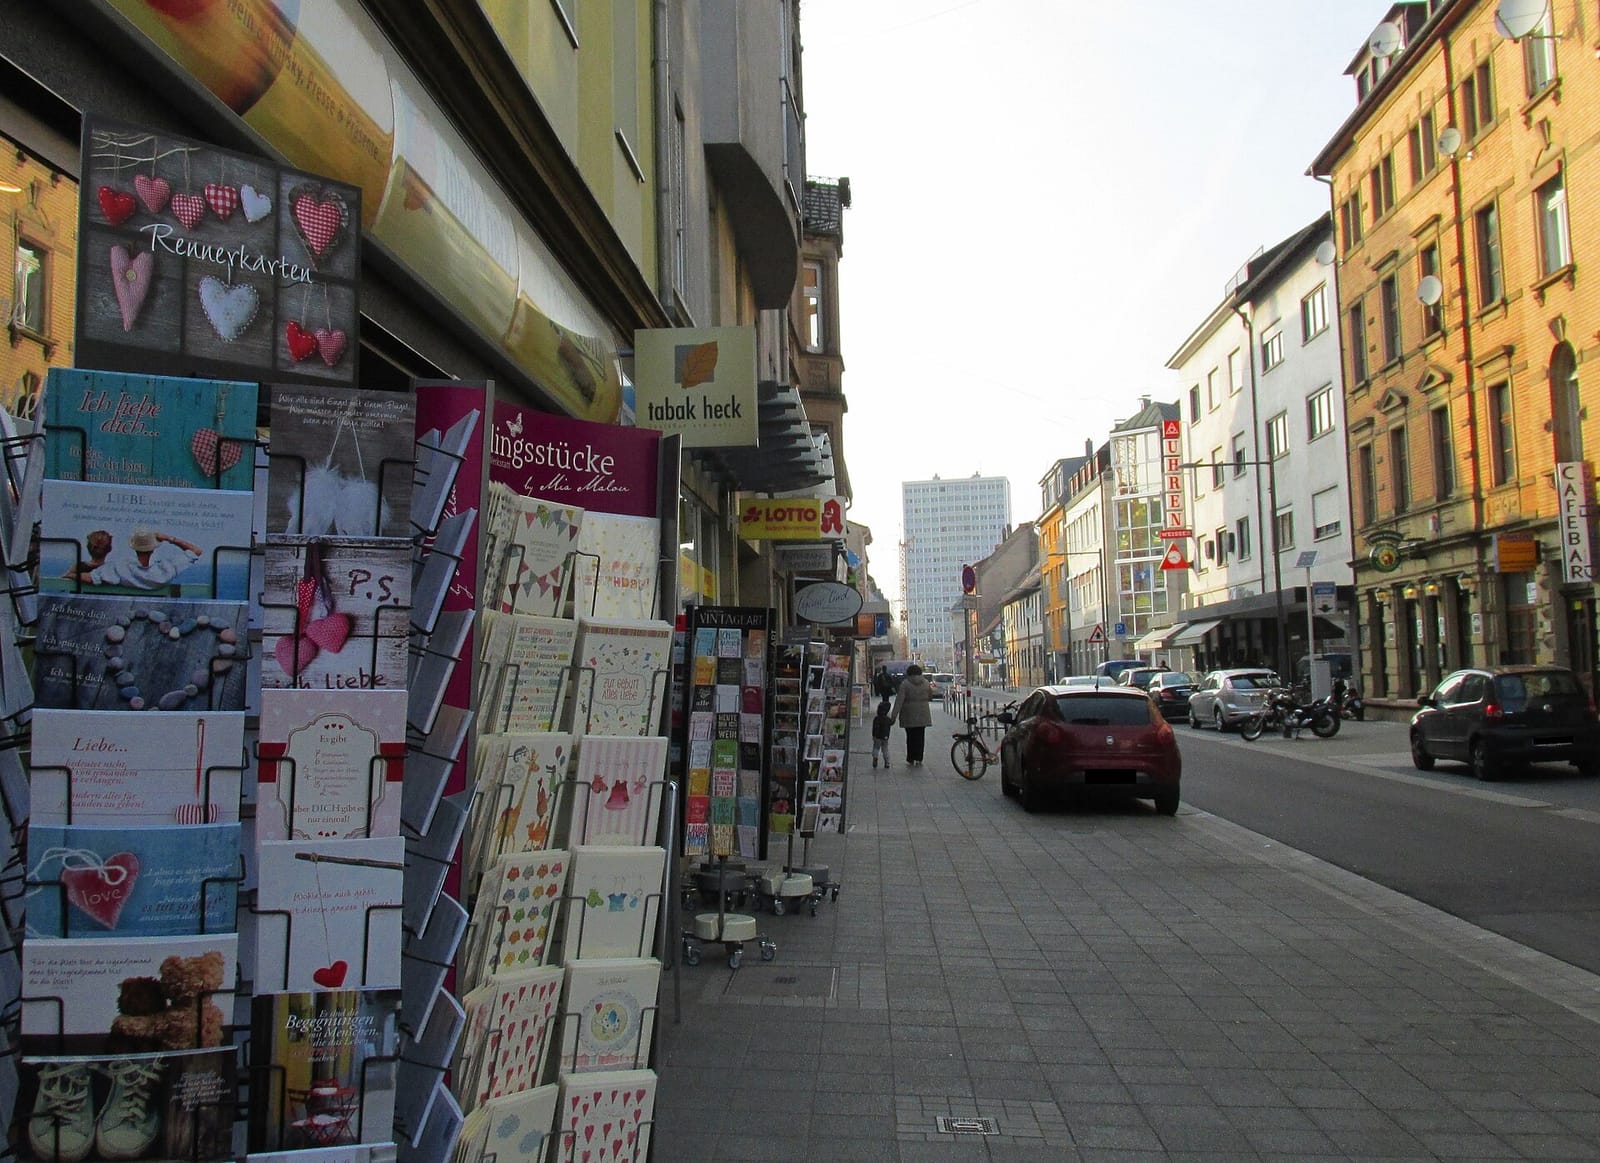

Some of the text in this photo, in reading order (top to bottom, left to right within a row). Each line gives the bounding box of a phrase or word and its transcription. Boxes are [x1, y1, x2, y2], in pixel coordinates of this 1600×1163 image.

[139, 223, 313, 285] Rennerkarten
[79, 390, 161, 417] Ich liebe
[648, 394, 742, 421] tabak heck
[100, 412, 160, 437] dich...
[1167, 439, 1182, 528] UHREN
[765, 508, 817, 522] LOTTO
[700, 612, 763, 625] VINTAGE ART
[72, 737, 127, 752] Liebe...
[82, 888, 122, 905] love
[285, 1014, 375, 1033] Begegnungen
